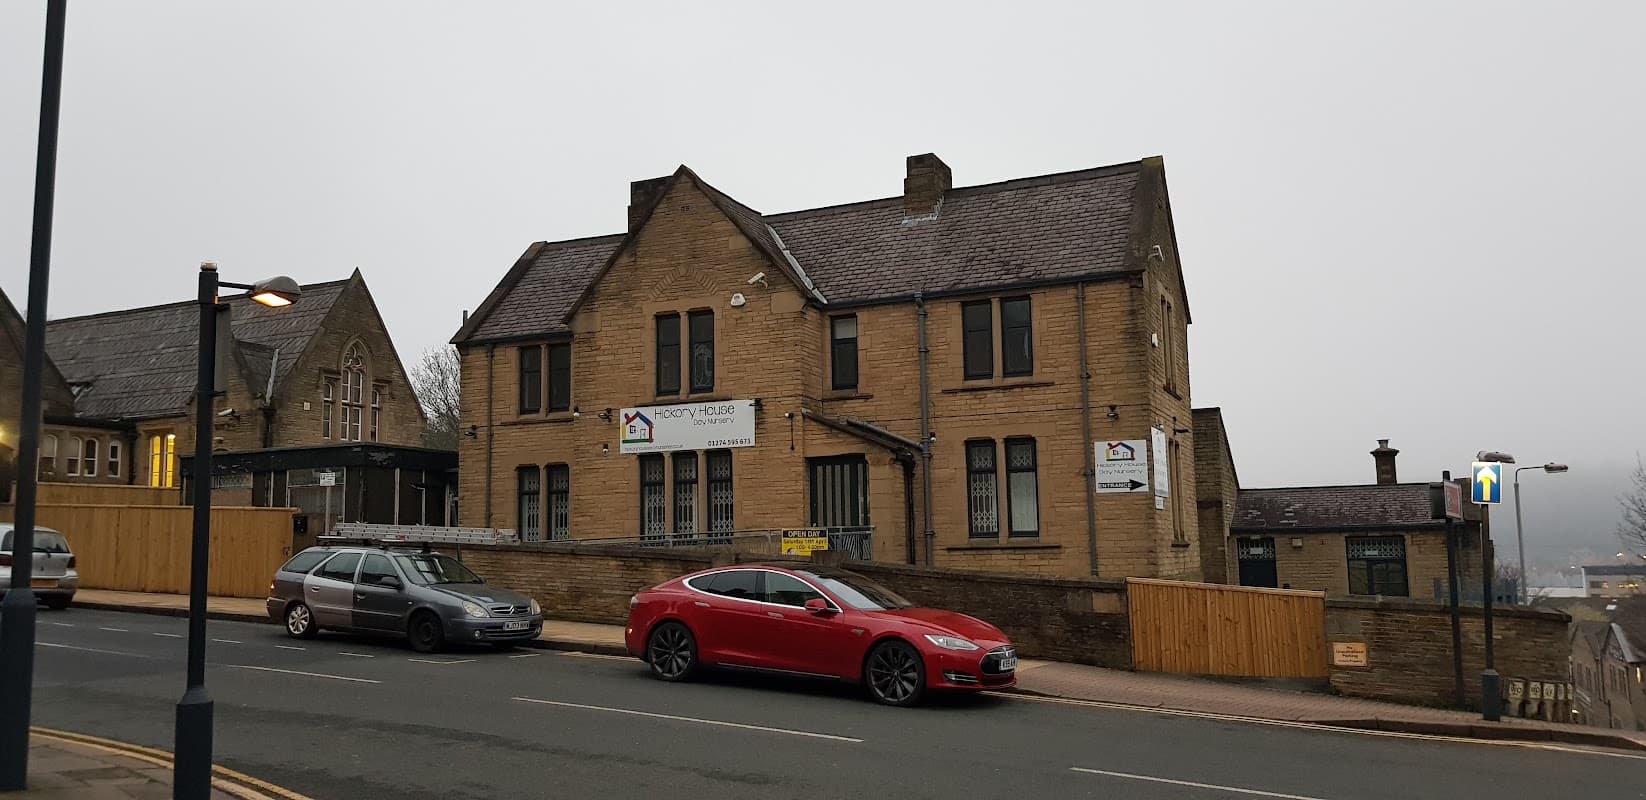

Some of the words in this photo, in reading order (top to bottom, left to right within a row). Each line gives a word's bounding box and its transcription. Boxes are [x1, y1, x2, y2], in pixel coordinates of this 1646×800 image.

[654, 407, 697, 419] Hickory
[699, 404, 735, 417] House
[787, 530, 807, 538] OPEN
[807, 530, 821, 538] DAY
